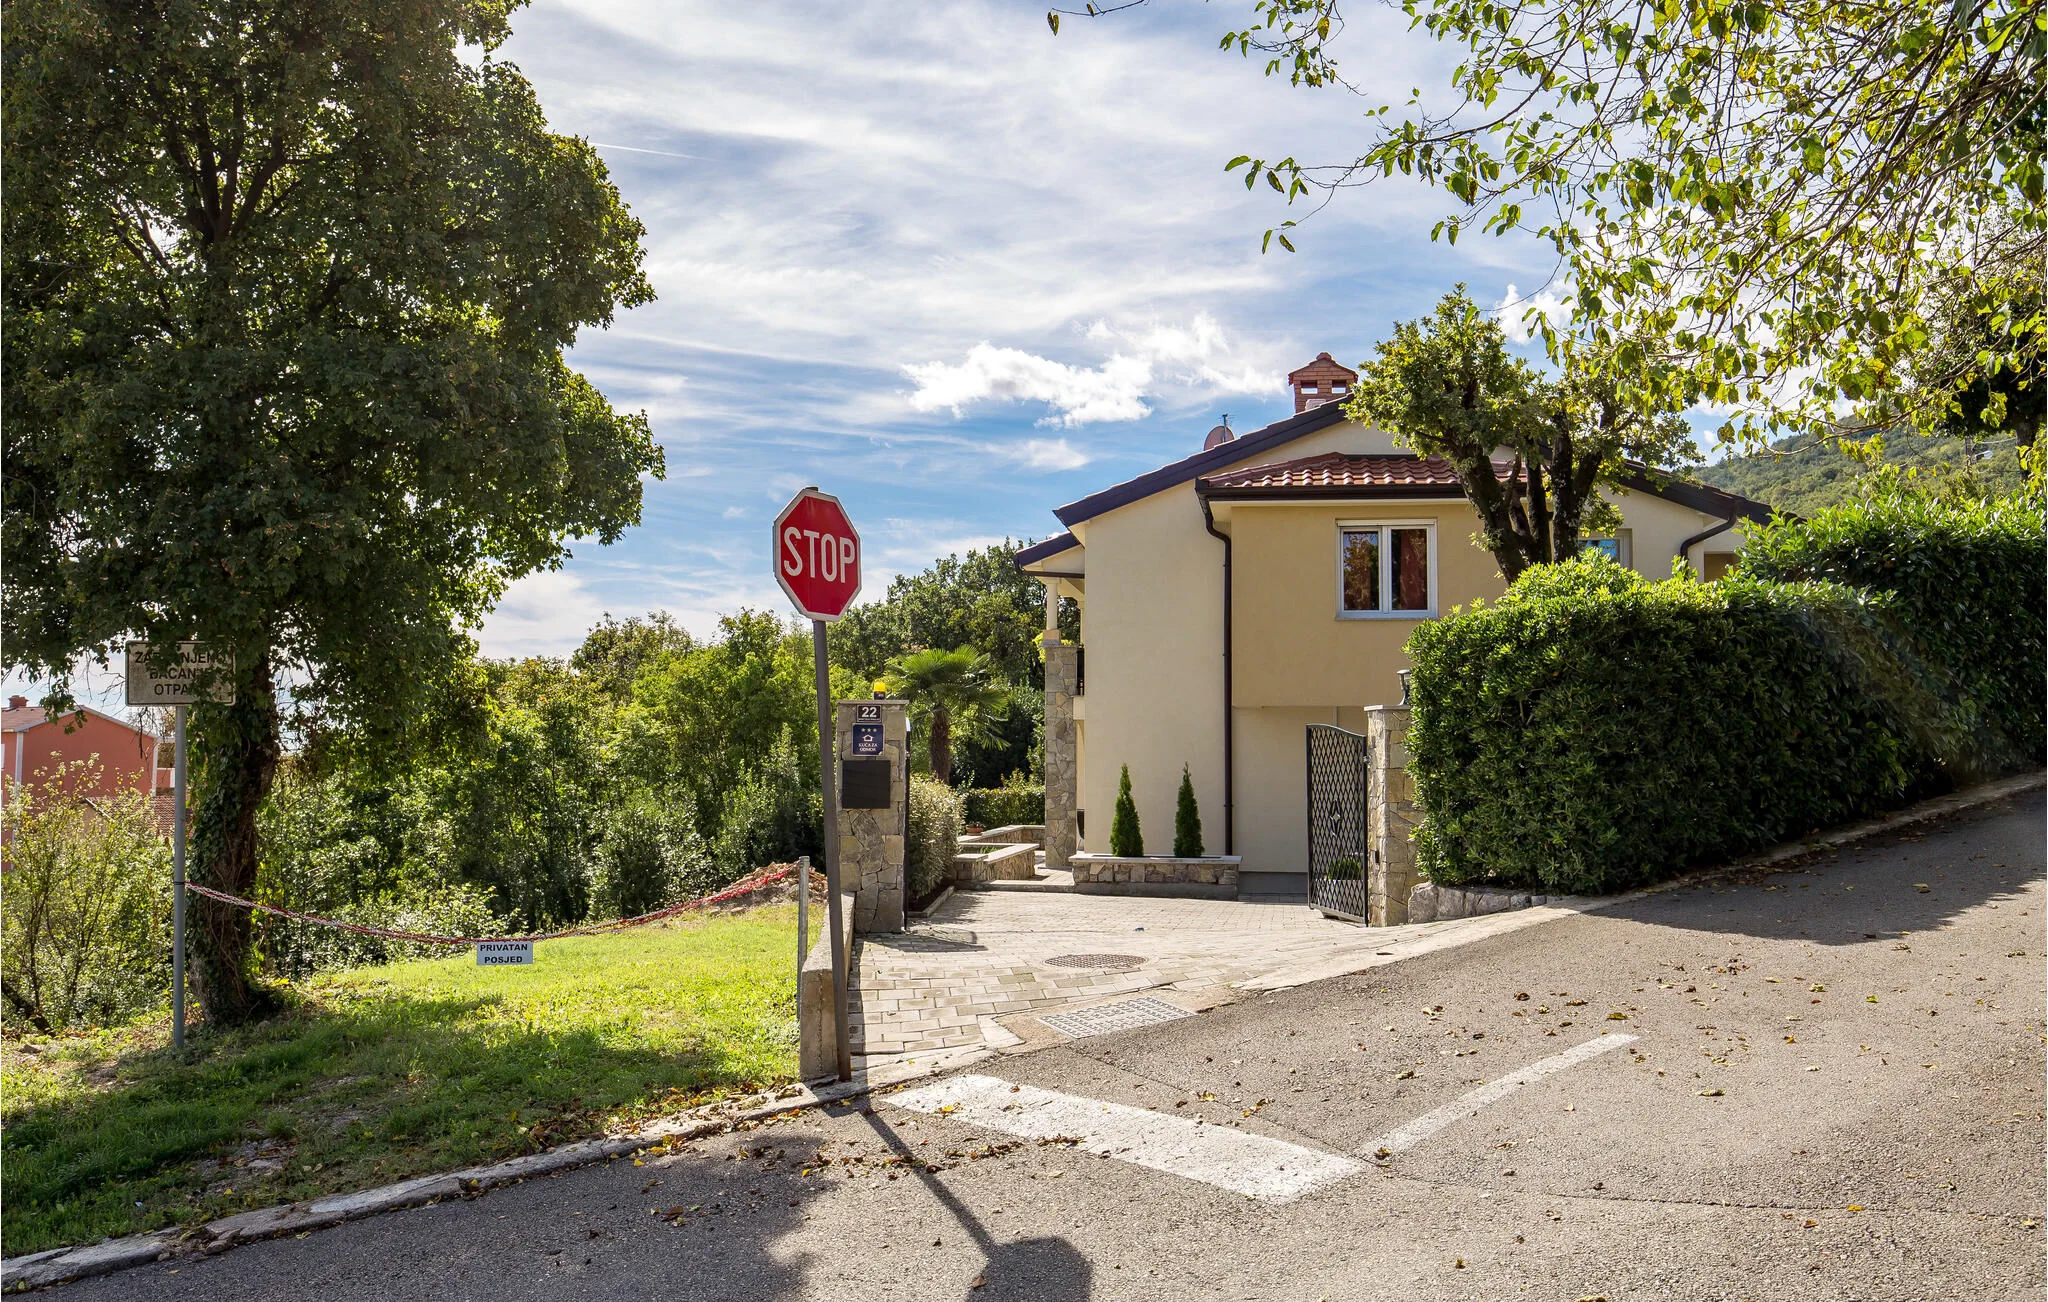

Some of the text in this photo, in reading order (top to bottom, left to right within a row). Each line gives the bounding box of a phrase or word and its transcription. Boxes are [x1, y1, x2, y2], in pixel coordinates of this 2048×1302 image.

[783, 526, 856, 584] STOP
[861, 706, 877, 718] 22
[480, 943, 528, 951] PRIVATAN
[484, 956, 523, 964] POSJED
